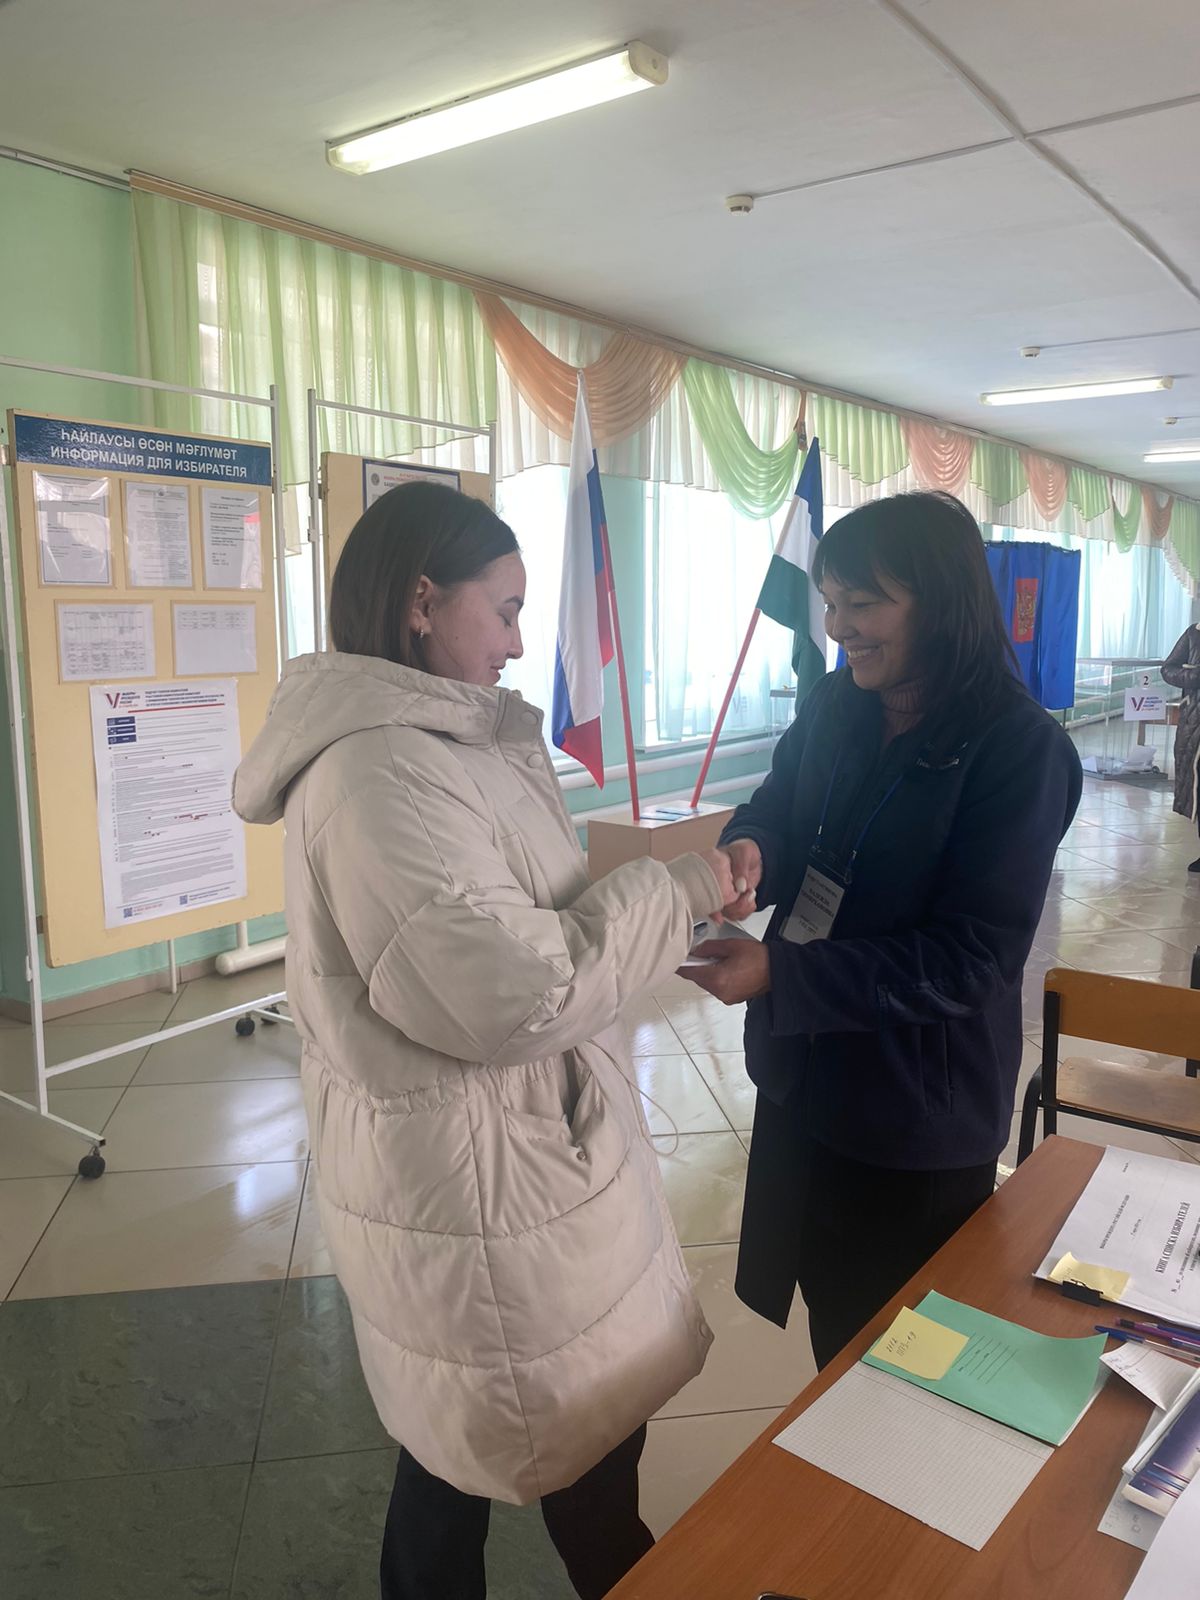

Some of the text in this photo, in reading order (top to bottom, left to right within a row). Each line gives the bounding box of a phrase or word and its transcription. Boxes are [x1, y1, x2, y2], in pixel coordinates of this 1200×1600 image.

[138, 438, 173, 452] ӨСӨН
[50, 445, 247, 478] ИНФОРМАЦИЯ ДЛЯ ИЗБИРАТЕЛЯ
[1143, 676, 1149, 685] 2
